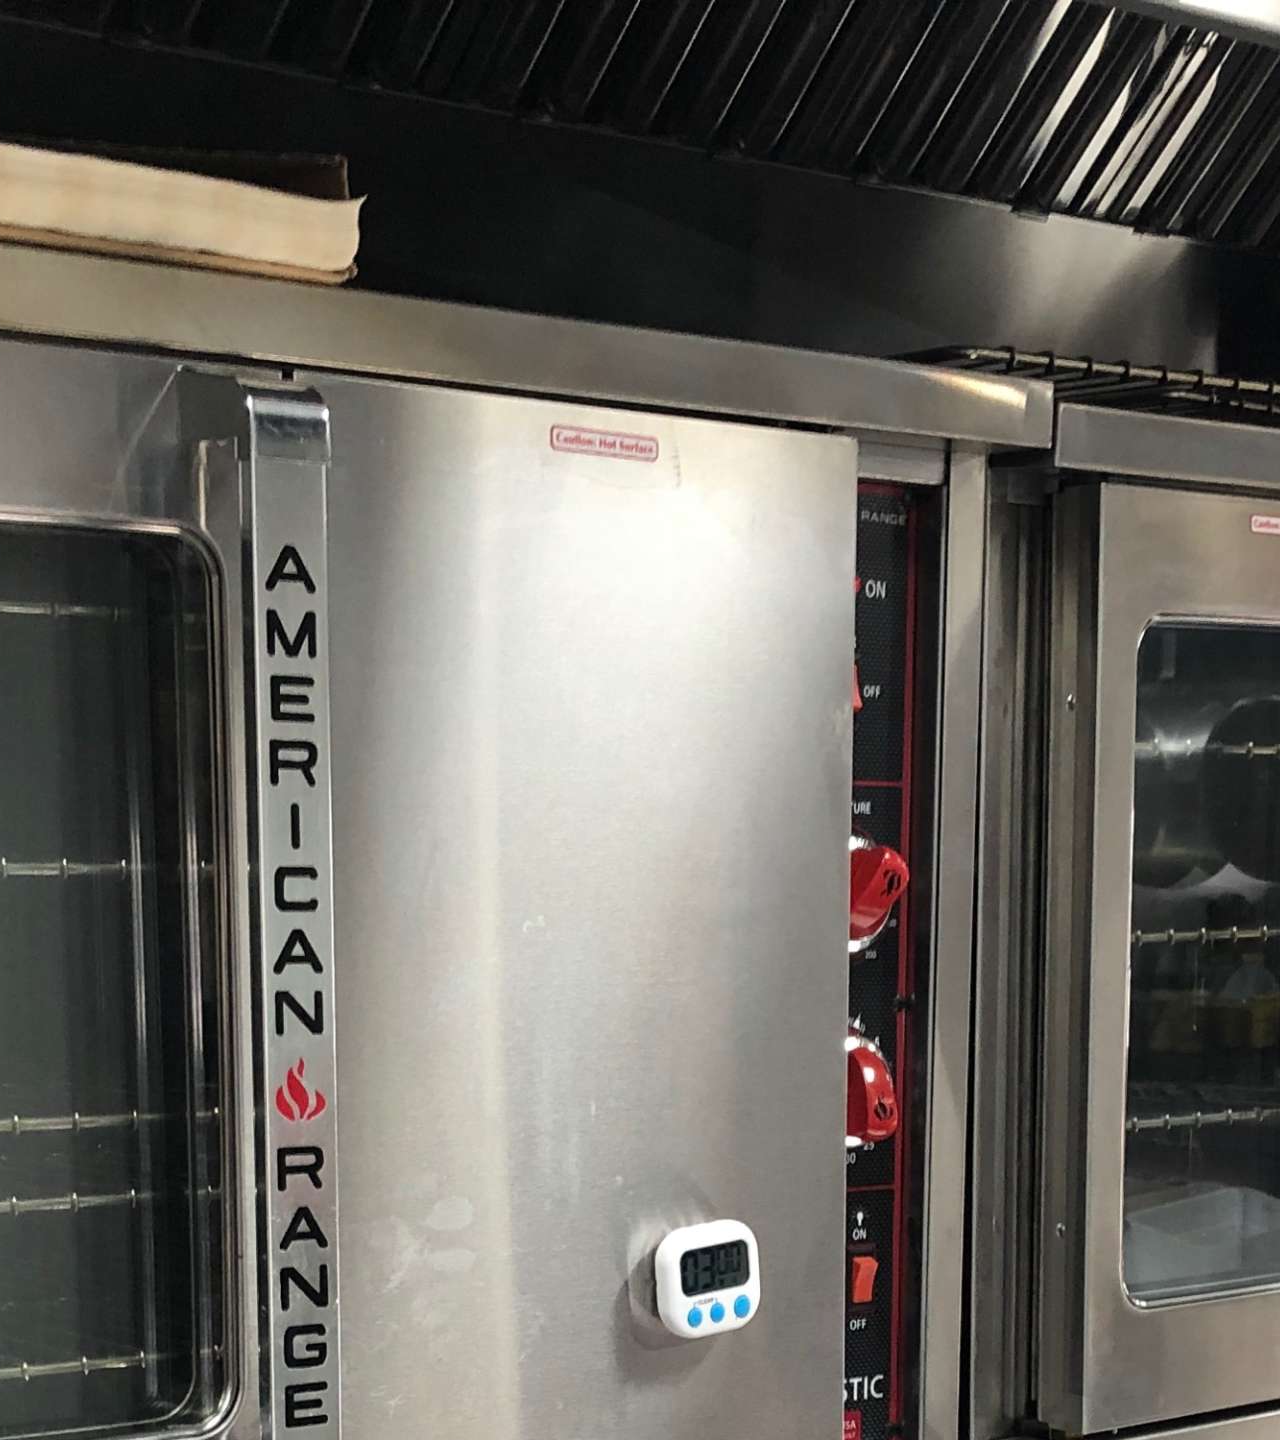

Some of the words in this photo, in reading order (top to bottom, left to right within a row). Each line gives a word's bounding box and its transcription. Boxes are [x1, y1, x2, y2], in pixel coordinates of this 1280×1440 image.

[865, 579, 886, 600] ON
[863, 684, 880, 700] OFF
[265, 545, 324, 1036] AMERICAN
[851, 801, 871, 815] URE
[852, 1228, 867, 1240] ON
[277, 1146, 328, 1428] RANGE
[849, 1318, 867, 1331] OFF
